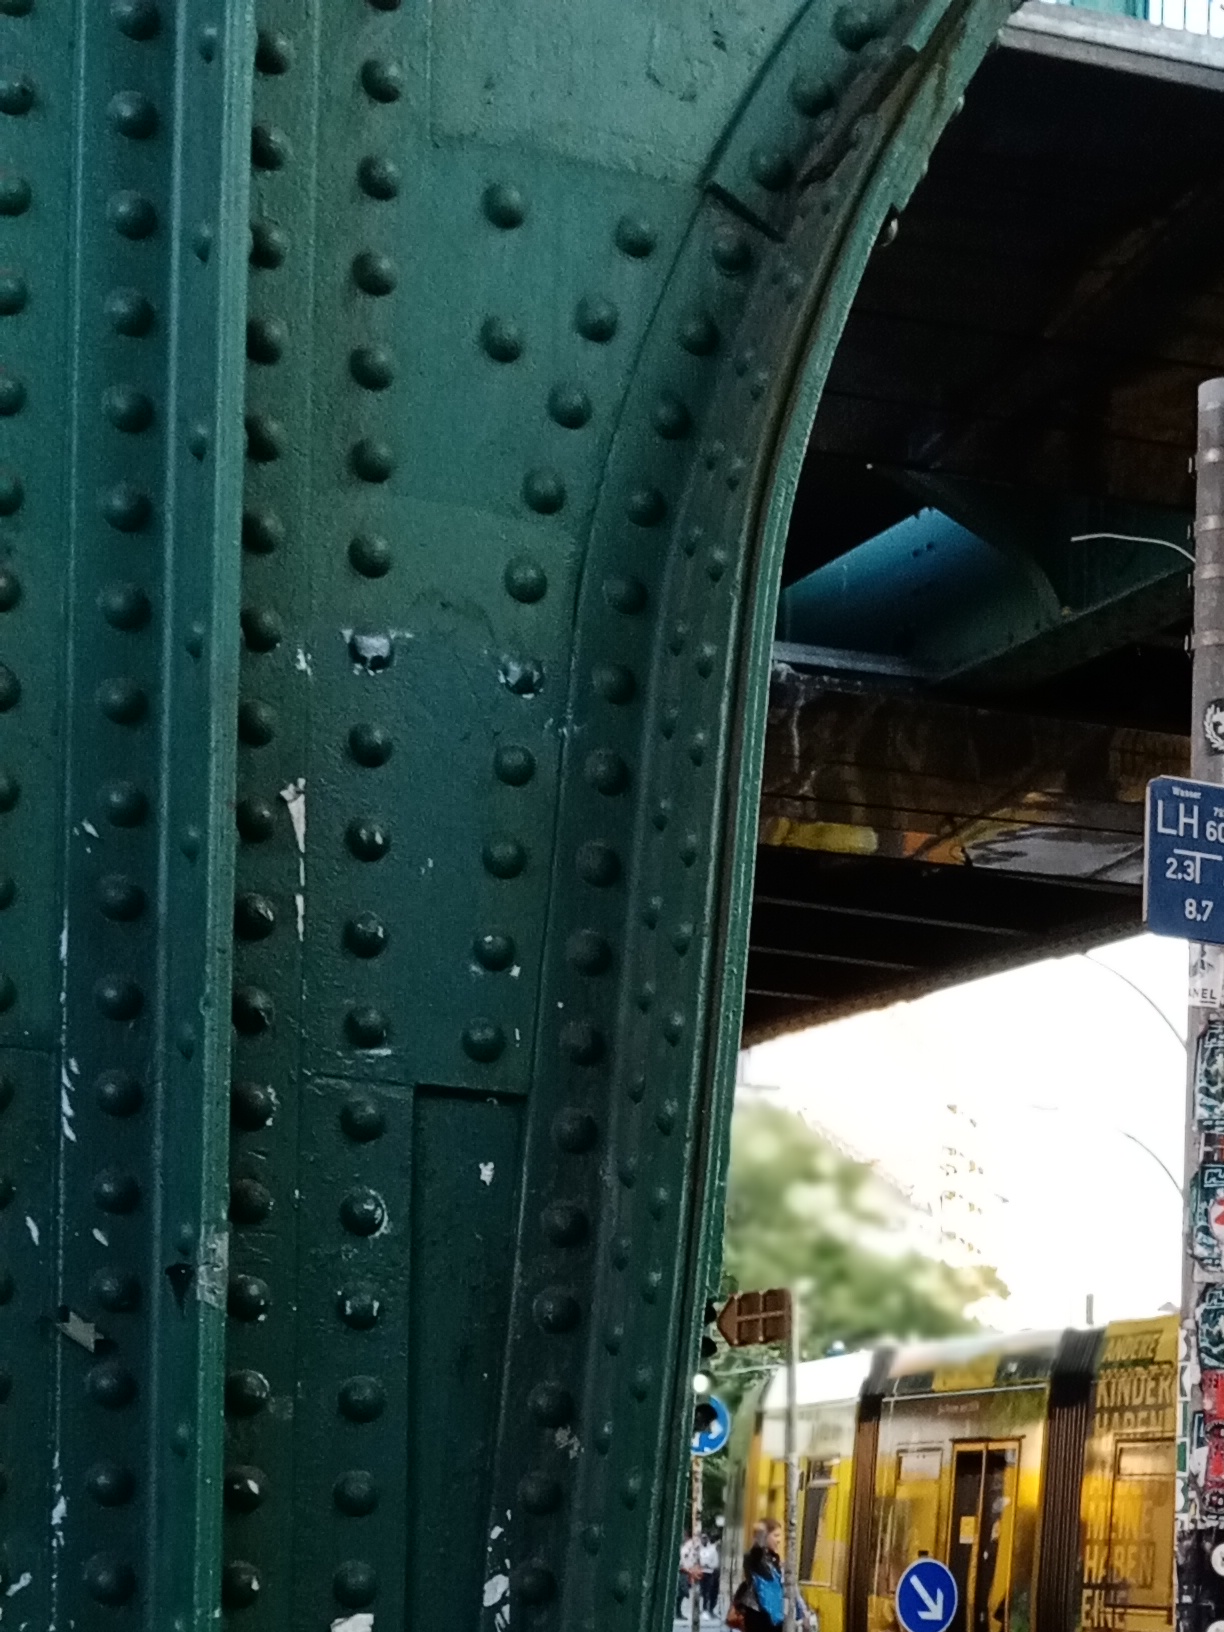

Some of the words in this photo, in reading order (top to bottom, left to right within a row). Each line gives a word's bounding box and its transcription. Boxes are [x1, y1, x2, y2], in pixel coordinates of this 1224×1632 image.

[1171, 786, 1202, 799] Wasser
[1157, 799, 1199, 839] LH
[1165, 857, 1194, 882] 2.3
[1184, 898, 1213, 922] 8.7
[1096, 1367, 1172, 1407] KINDER
[1083, 1544, 1154, 1589] HABEN
[1081, 1589, 1126, 1629] EINE
